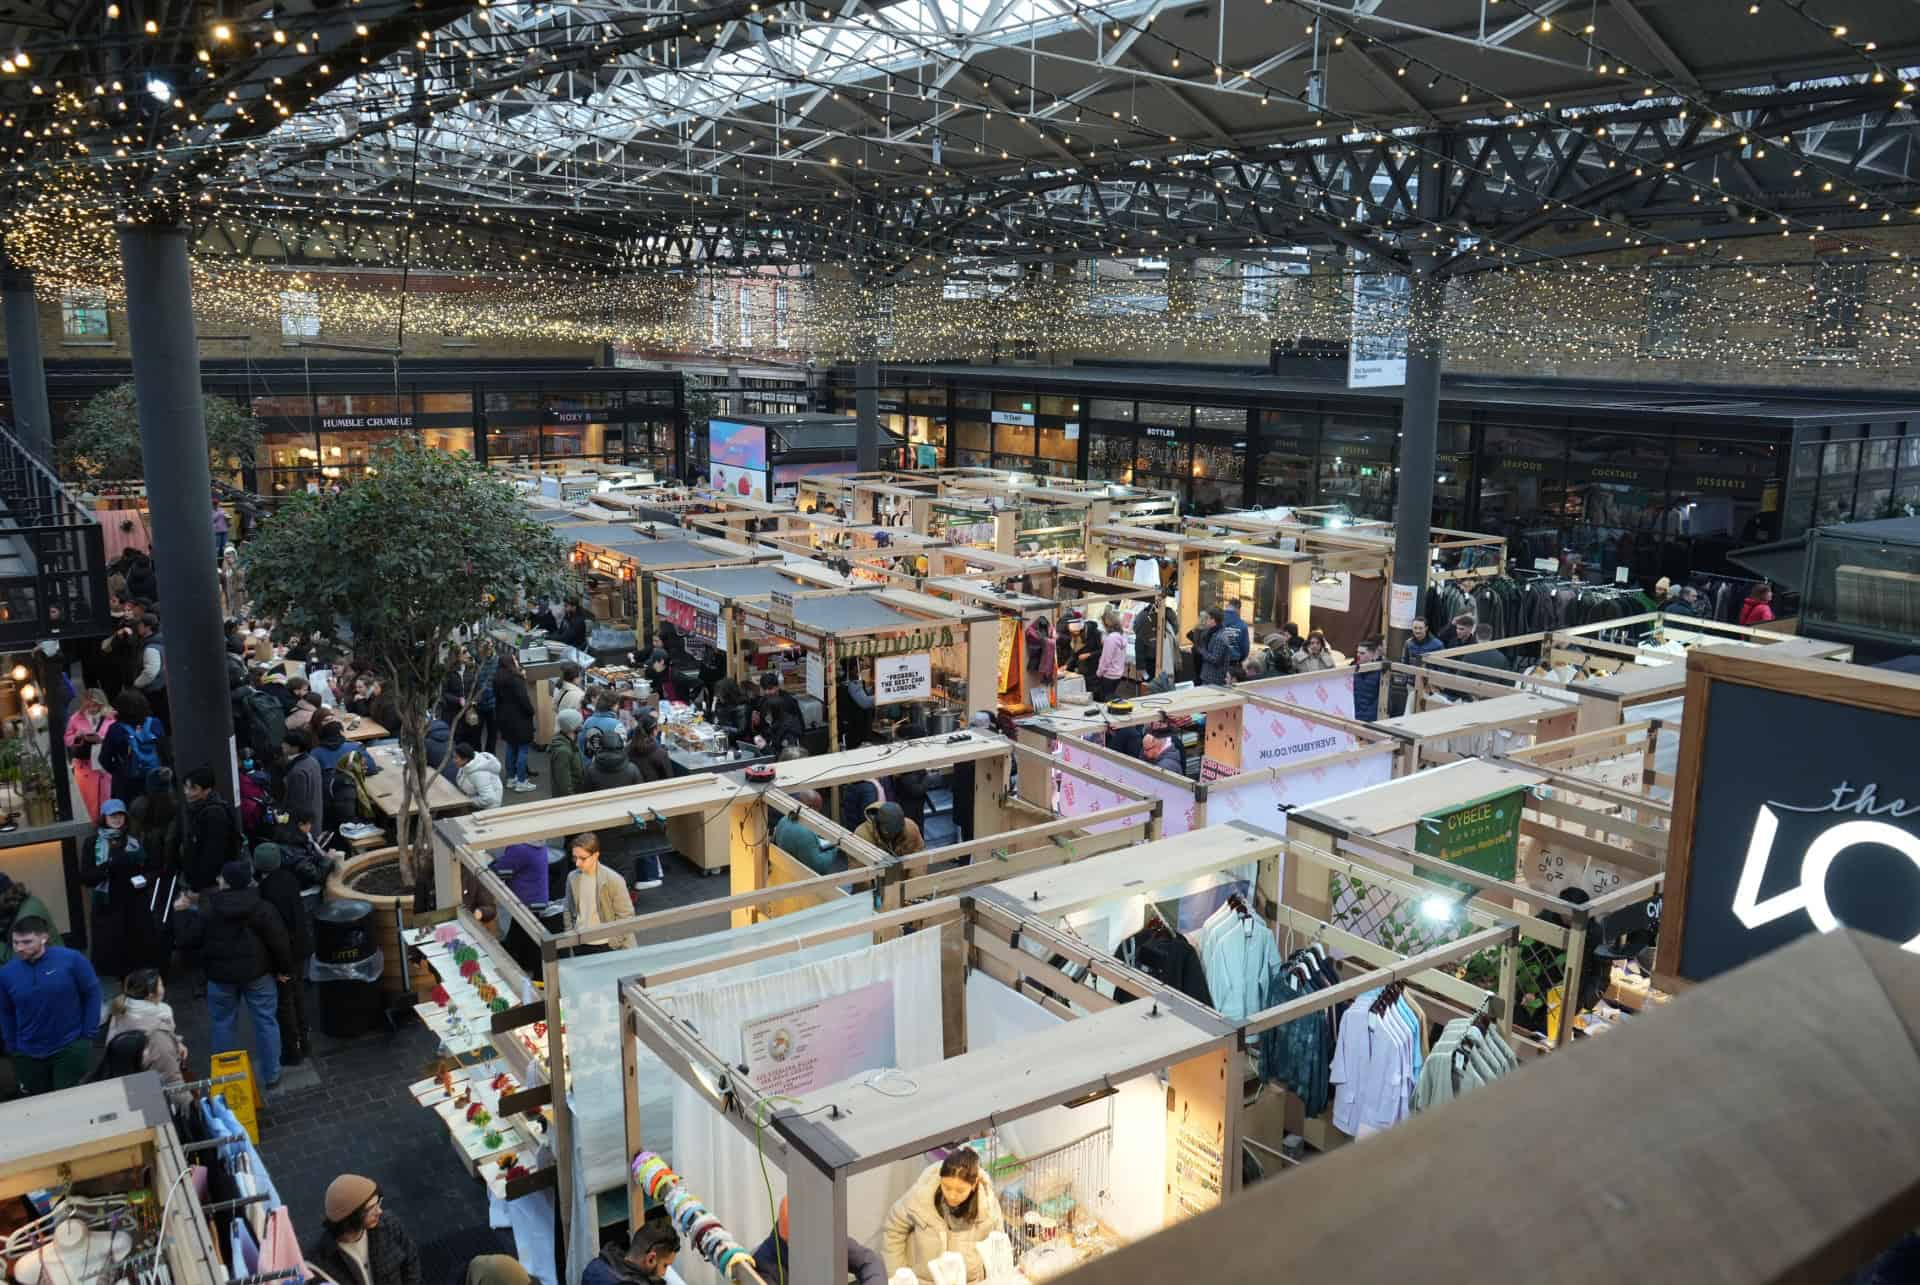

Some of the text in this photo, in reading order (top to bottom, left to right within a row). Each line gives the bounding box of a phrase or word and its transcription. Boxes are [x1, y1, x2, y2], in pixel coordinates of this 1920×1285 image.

[323, 418, 365, 428] HUMBLE
[1147, 428, 1175, 437] BOTTLES
[1591, 467, 1639, 480] COCKTAILS
[1696, 477, 1746, 489] DESSERTS
[881, 680, 893, 688] THE
[894, 678, 909, 686] BEST
[1767, 780, 1920, 817] the
[1447, 803, 1492, 830] CYBELE
